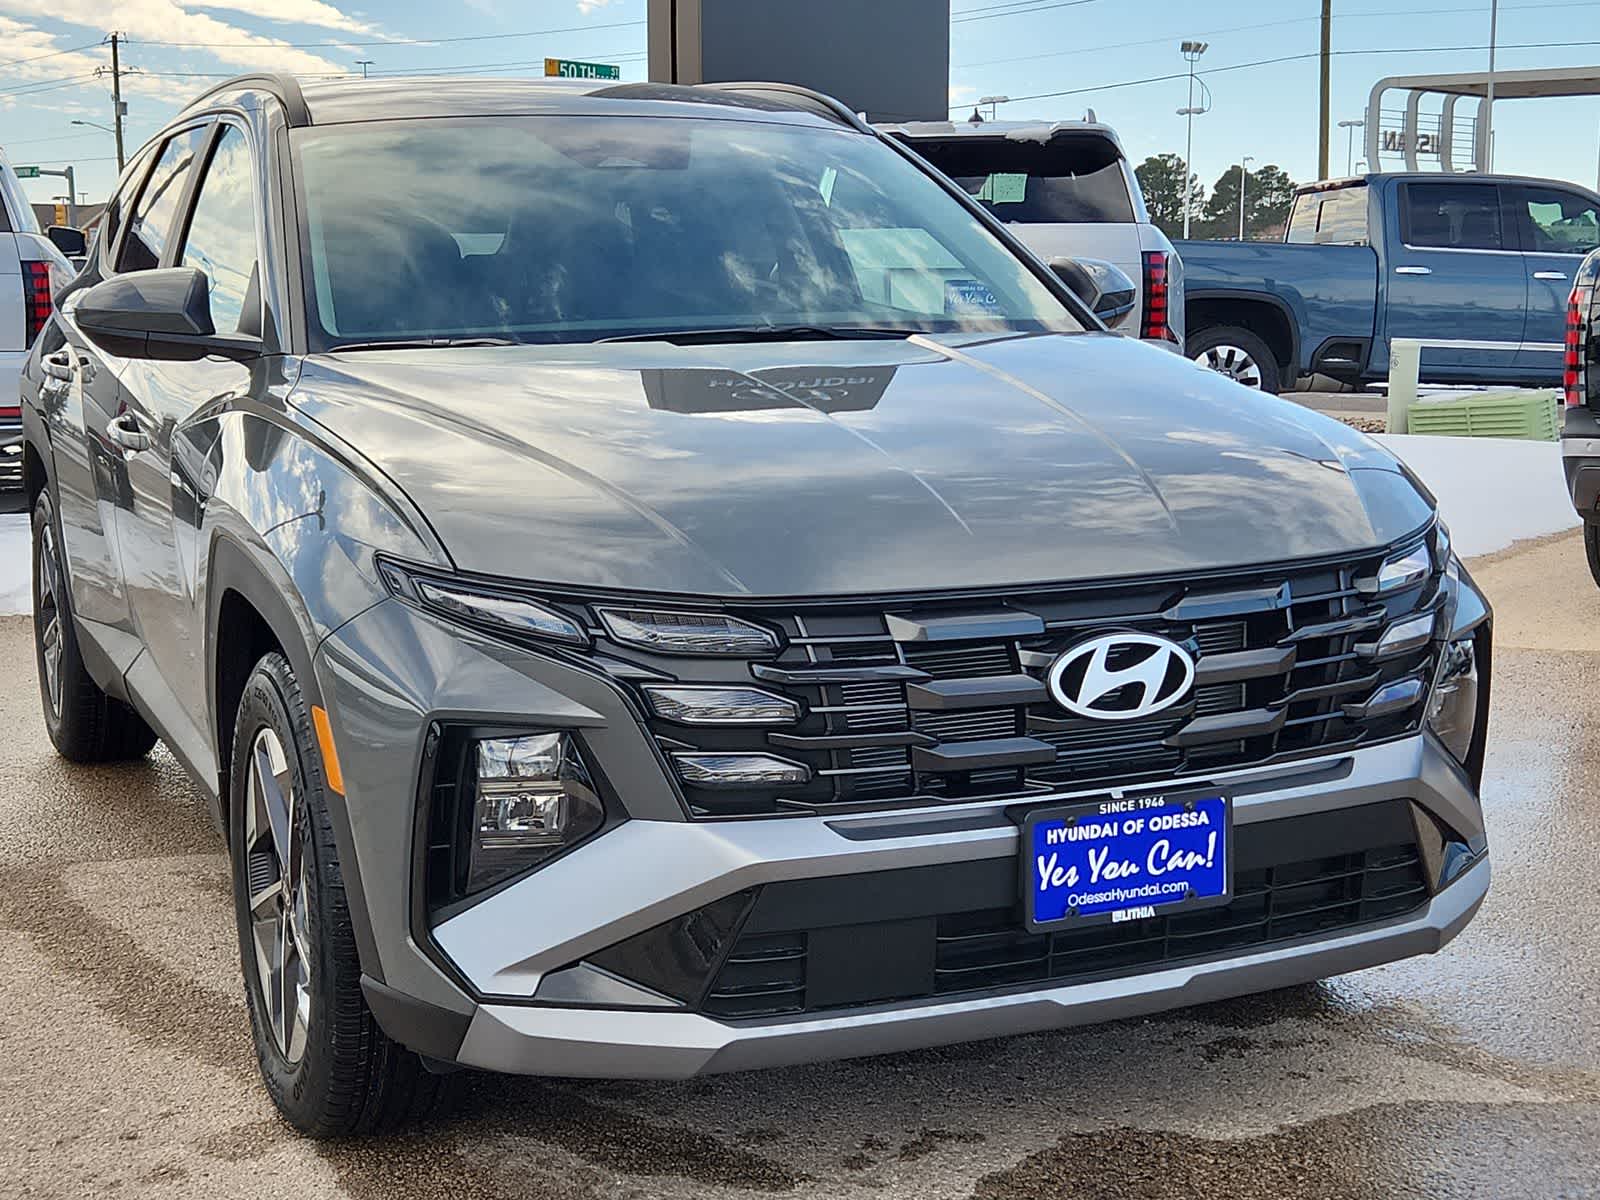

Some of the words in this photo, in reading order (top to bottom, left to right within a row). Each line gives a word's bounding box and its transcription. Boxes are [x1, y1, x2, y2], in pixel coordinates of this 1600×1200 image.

[560, 63, 577, 78] 50
[580, 65, 596, 79] TH
[1099, 800, 1135, 815] SINCE
[1138, 796, 1165, 810] 1946
[1046, 822, 1118, 845] HYUNDAI
[1123, 819, 1145, 835] OF
[1149, 810, 1210, 832] ODESSA
[1037, 851, 1080, 891] Yes
[1087, 845, 1141, 884] You
[1146, 831, 1217, 877] Can!
[1067, 880, 1190, 907] OdessaHyundai.com
[1122, 905, 1156, 921] LITHIA
